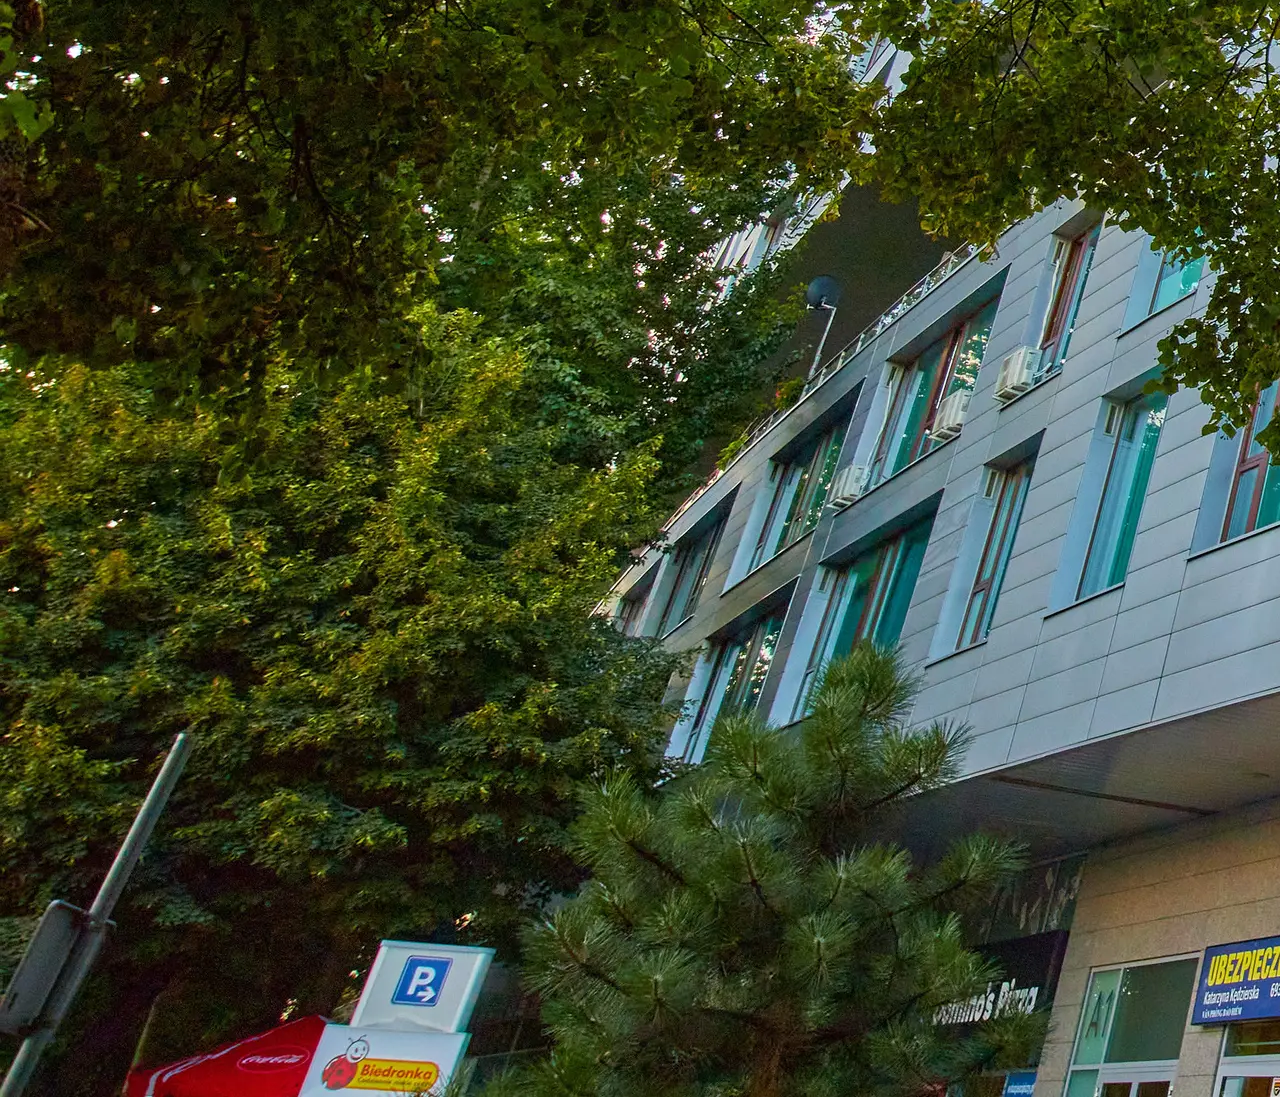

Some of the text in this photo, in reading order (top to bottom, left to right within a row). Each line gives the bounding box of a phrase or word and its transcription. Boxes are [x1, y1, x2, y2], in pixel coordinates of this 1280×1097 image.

[407, 966, 436, 995] P
[1203, 990, 1230, 1006] Katarzyna
[1270, 982, 1280, 997] 693
[360, 1064, 433, 1080] Biedronka
